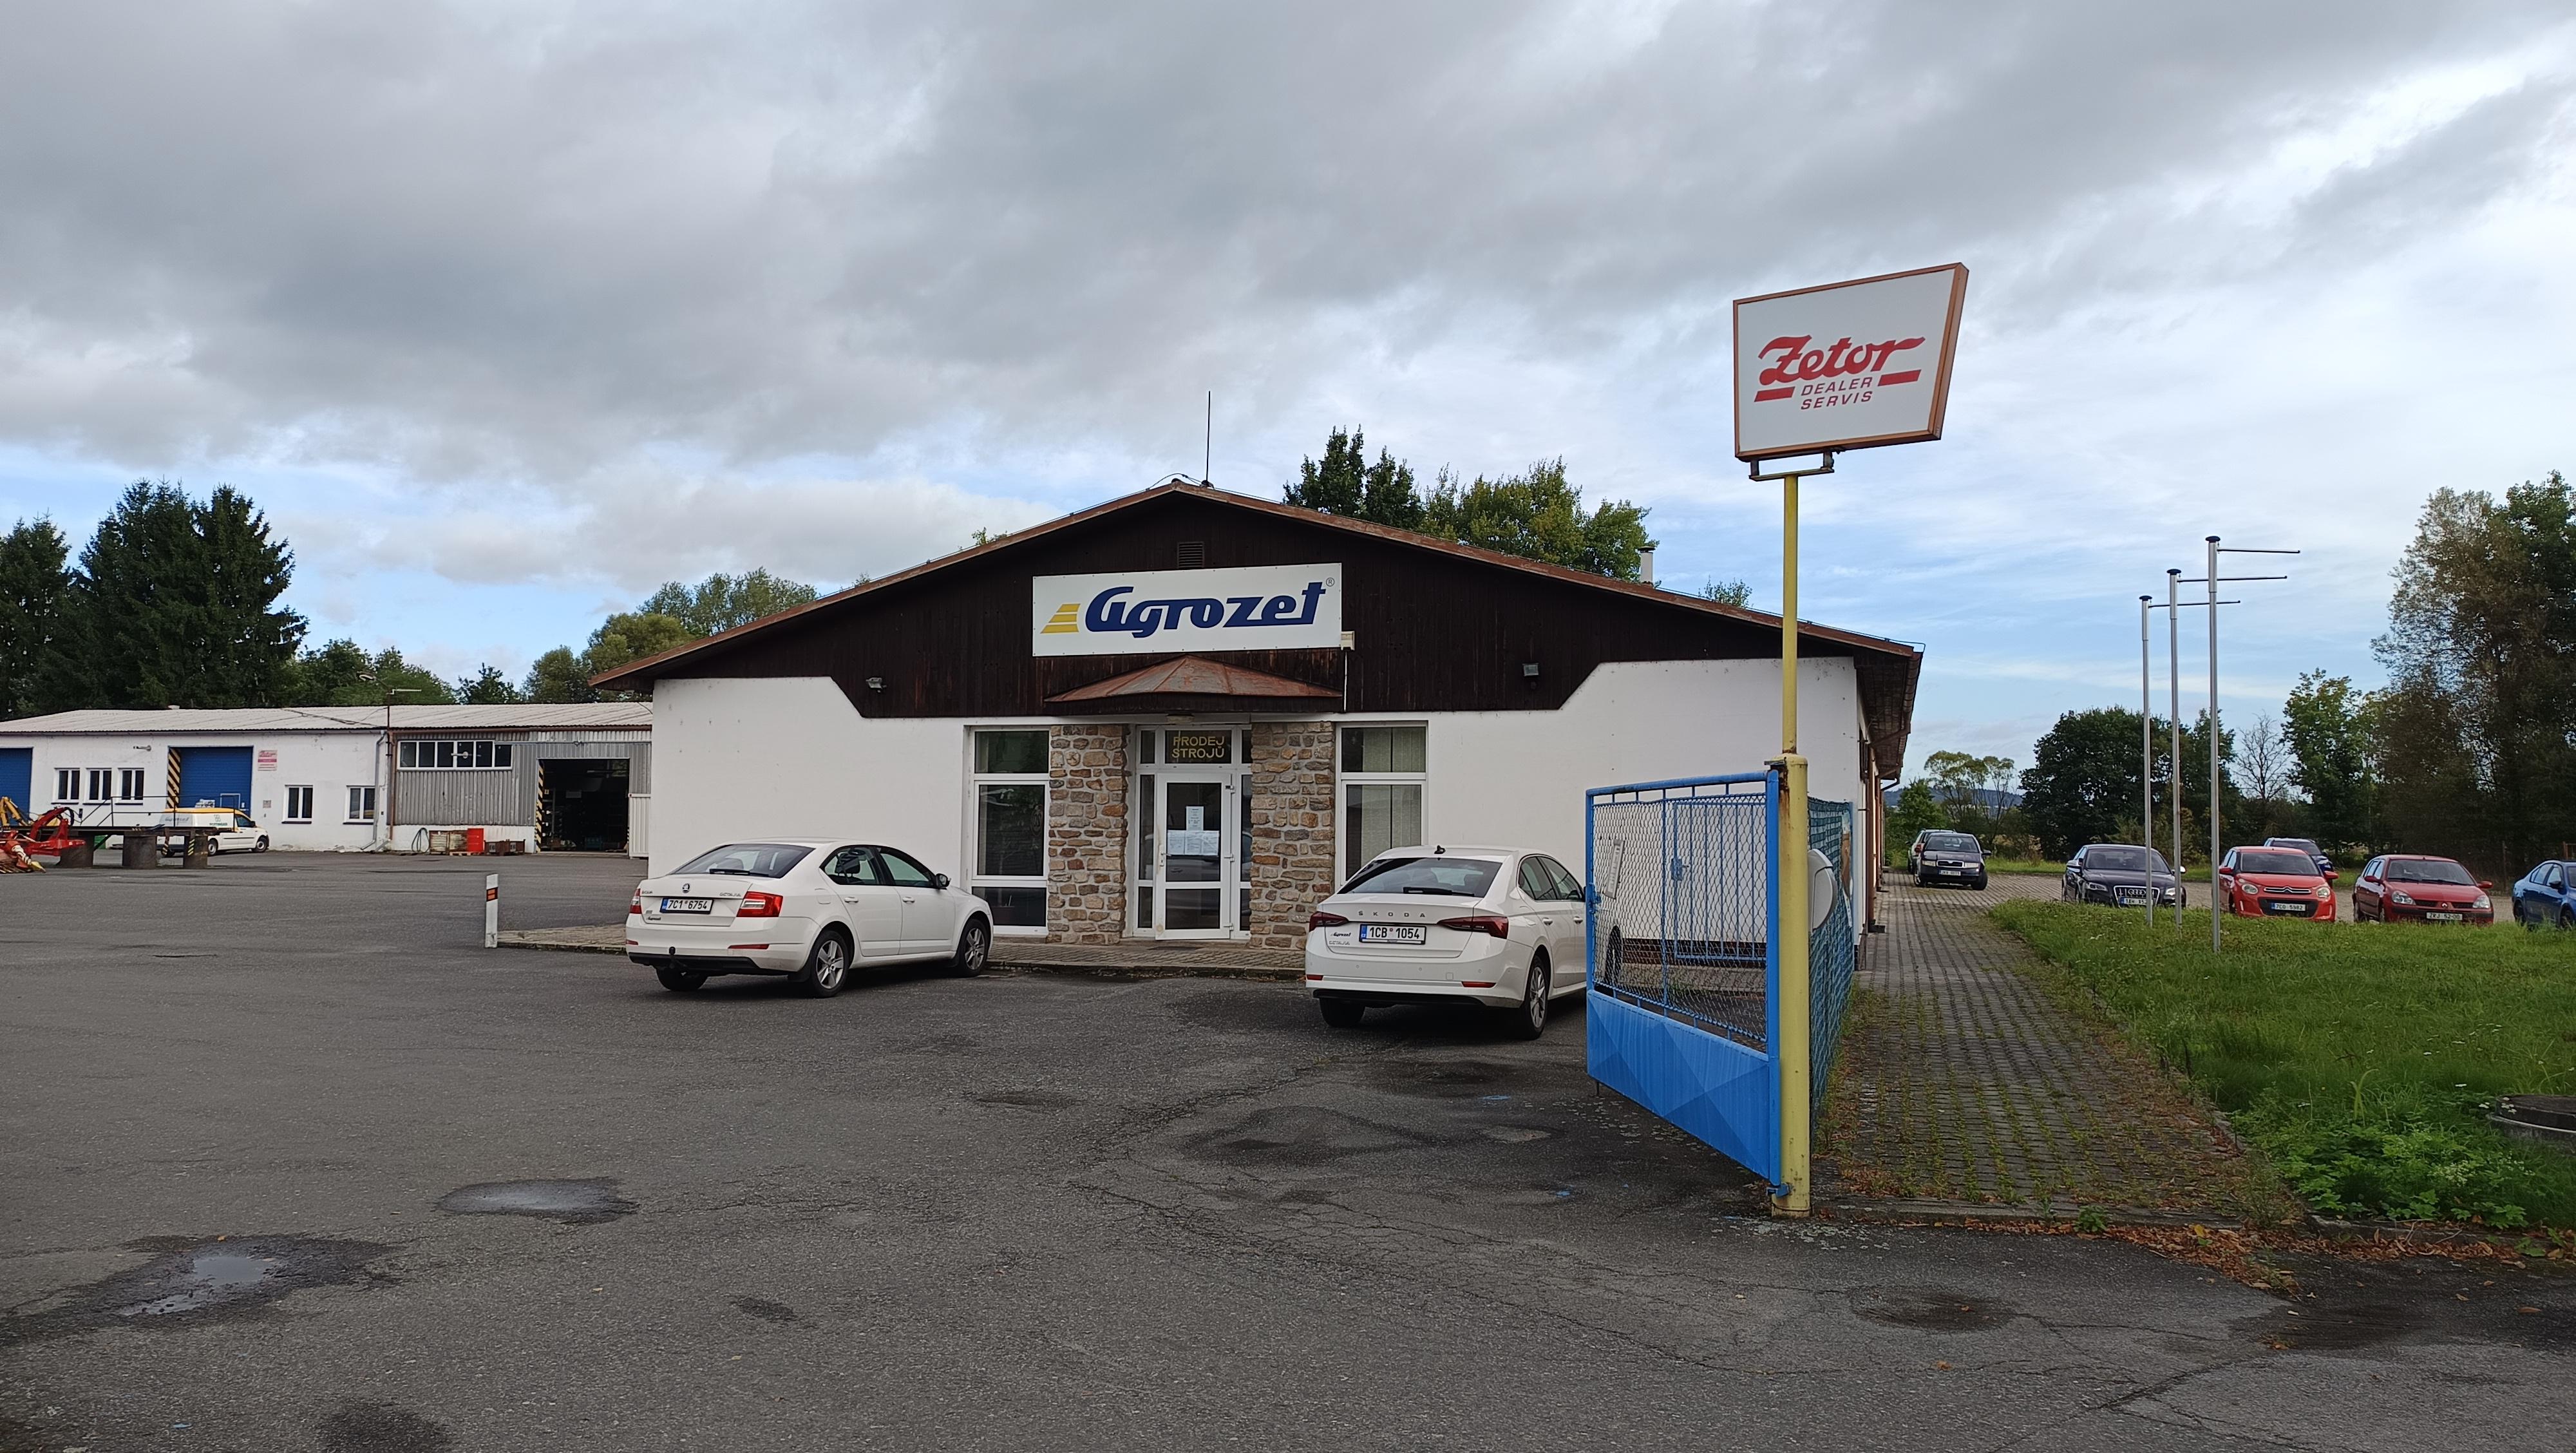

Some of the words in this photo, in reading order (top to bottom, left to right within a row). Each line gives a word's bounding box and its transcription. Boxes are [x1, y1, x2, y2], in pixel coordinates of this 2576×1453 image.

[1758, 335, 1926, 386] Zetor
[1801, 377, 1872, 396] DEALER
[1801, 391, 1872, 410] SERVIS
[1173, 736, 1225, 746] PRODEJ
[1171, 746, 1225, 758] STROJŮ
[668, 900, 683, 909] 7C1
[688, 900, 708, 909] 6754
[1369, 927, 1388, 938] 1CB
[1396, 927, 1420, 939] 1054
